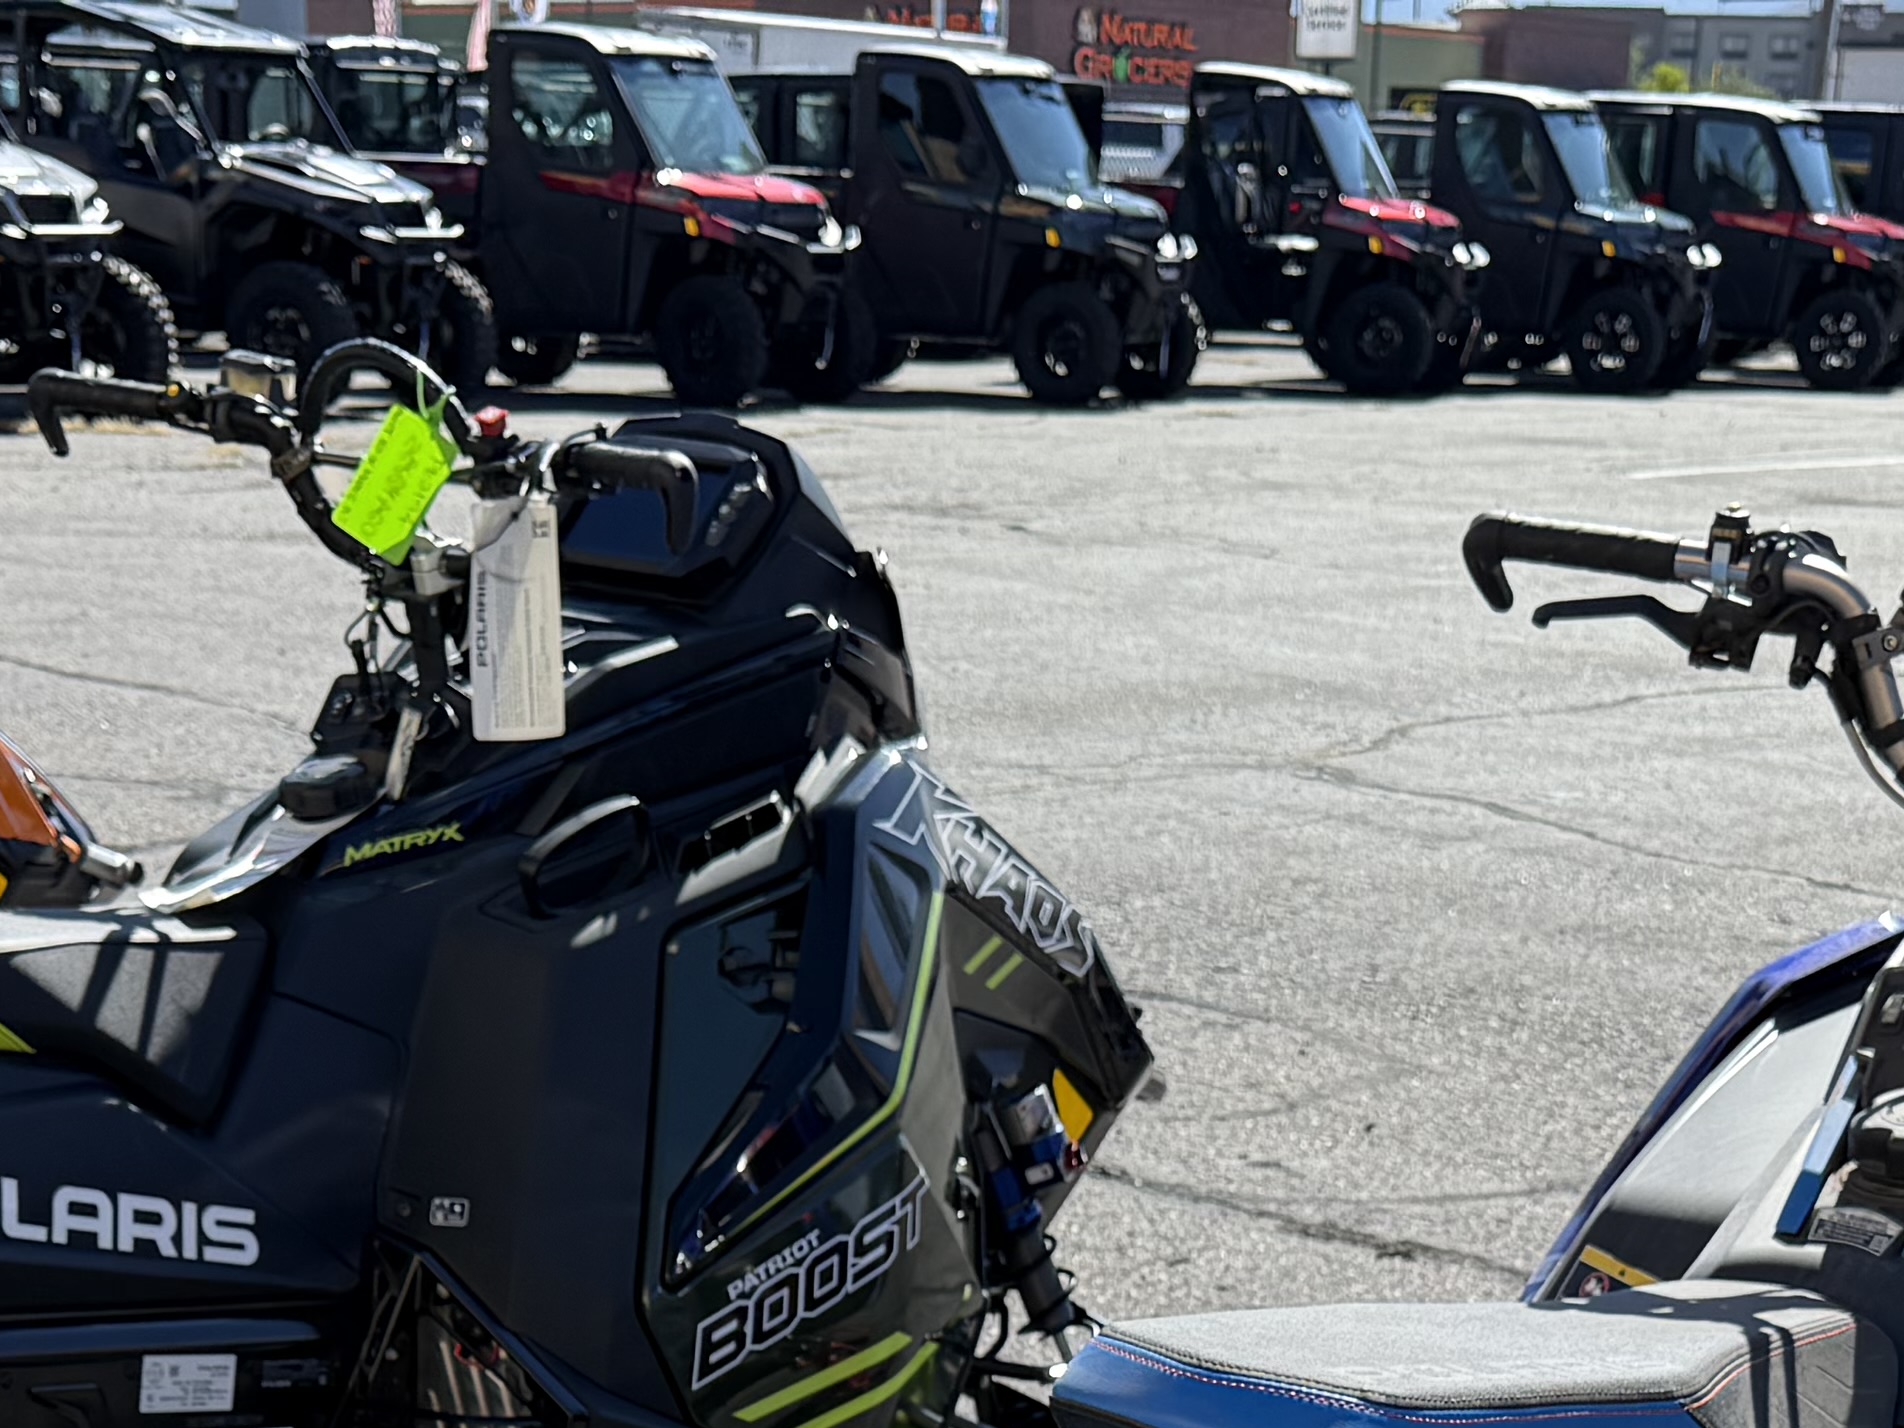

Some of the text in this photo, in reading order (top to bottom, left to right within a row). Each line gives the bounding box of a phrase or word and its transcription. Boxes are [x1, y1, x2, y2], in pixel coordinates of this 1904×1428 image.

[1101, 13, 1198, 51] NATURAL
[342, 822, 465, 867] MATRYX
[872, 760, 1094, 977] KHAOS
[692, 1175, 930, 1391] BOOST
[727, 1228, 820, 1300] PATRIOT
